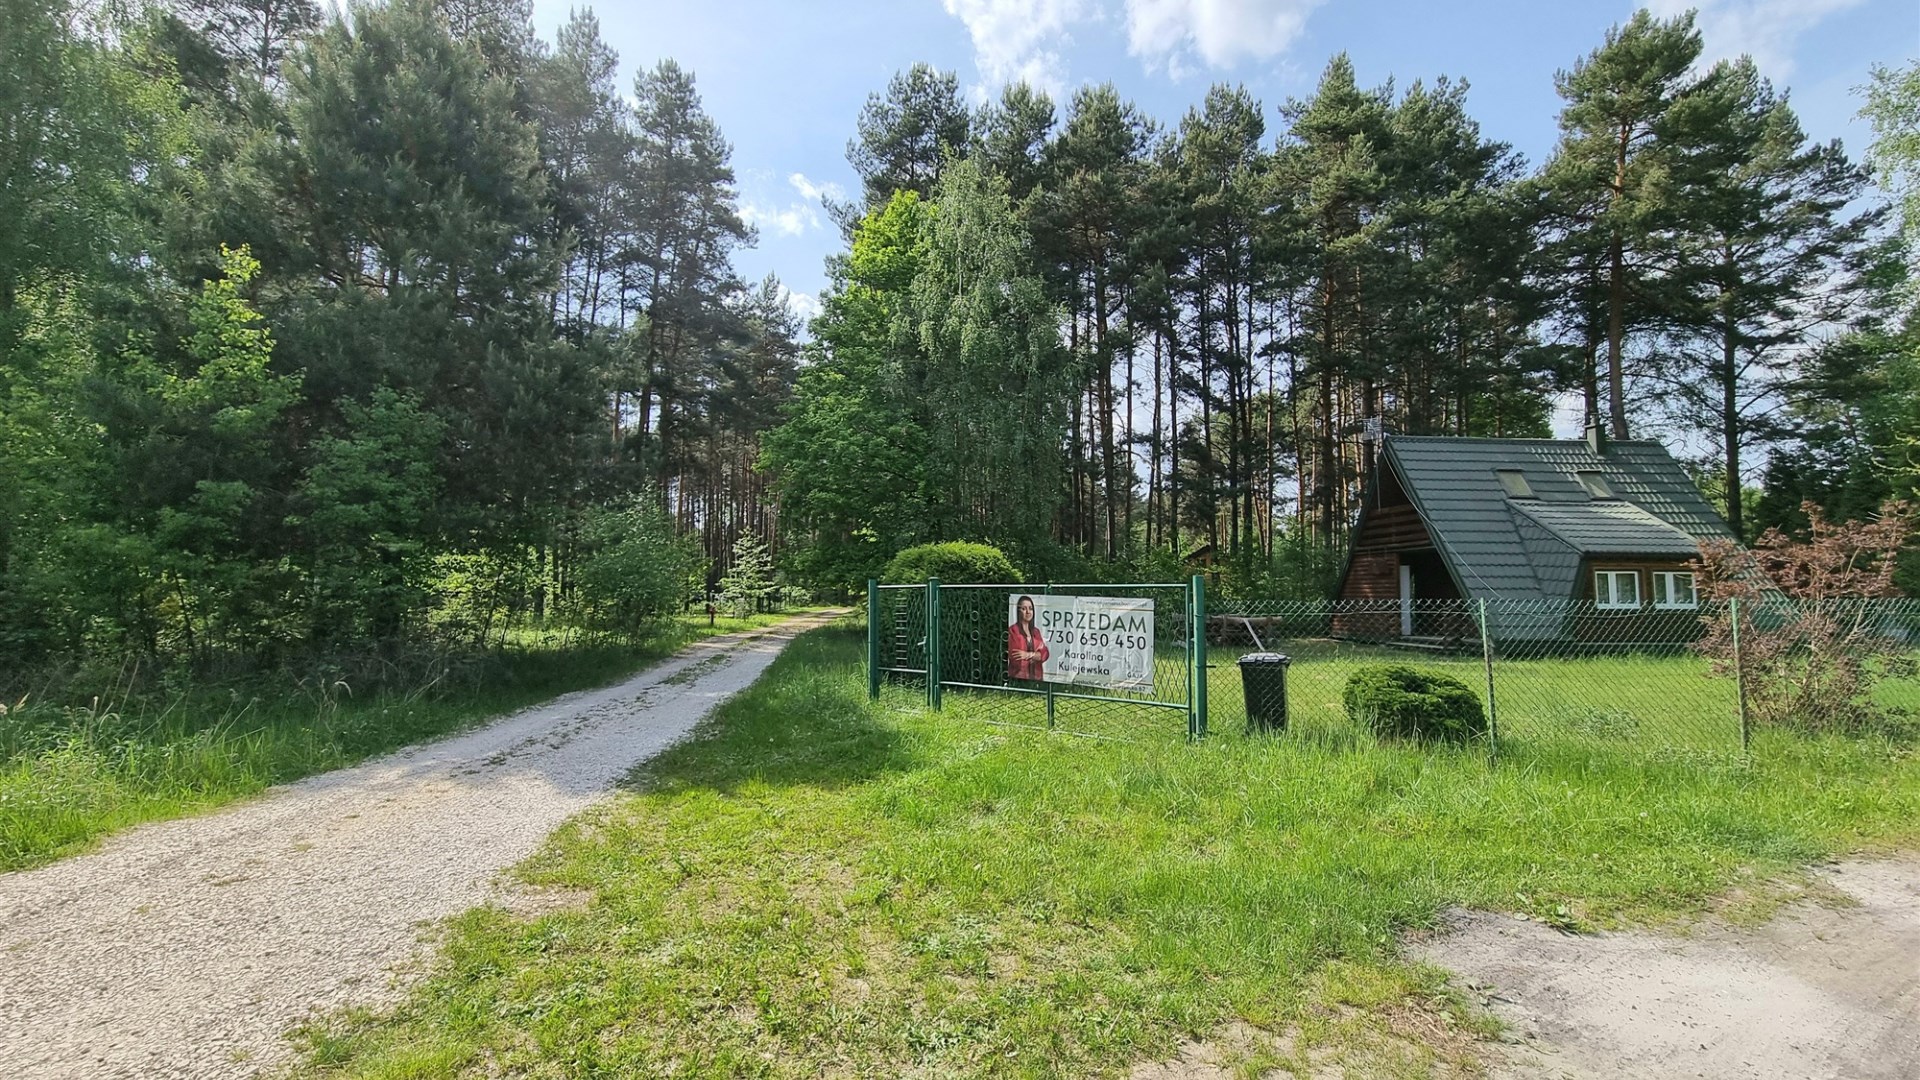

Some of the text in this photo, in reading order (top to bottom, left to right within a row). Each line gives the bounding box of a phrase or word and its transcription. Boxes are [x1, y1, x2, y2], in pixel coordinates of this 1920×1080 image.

[1042, 610, 1147, 633] SPRZEDAM
[1047, 629, 1147, 650] 730 650 450
[1064, 648, 1104, 662] Karolina
[1058, 661, 1110, 676] Kulejewska
